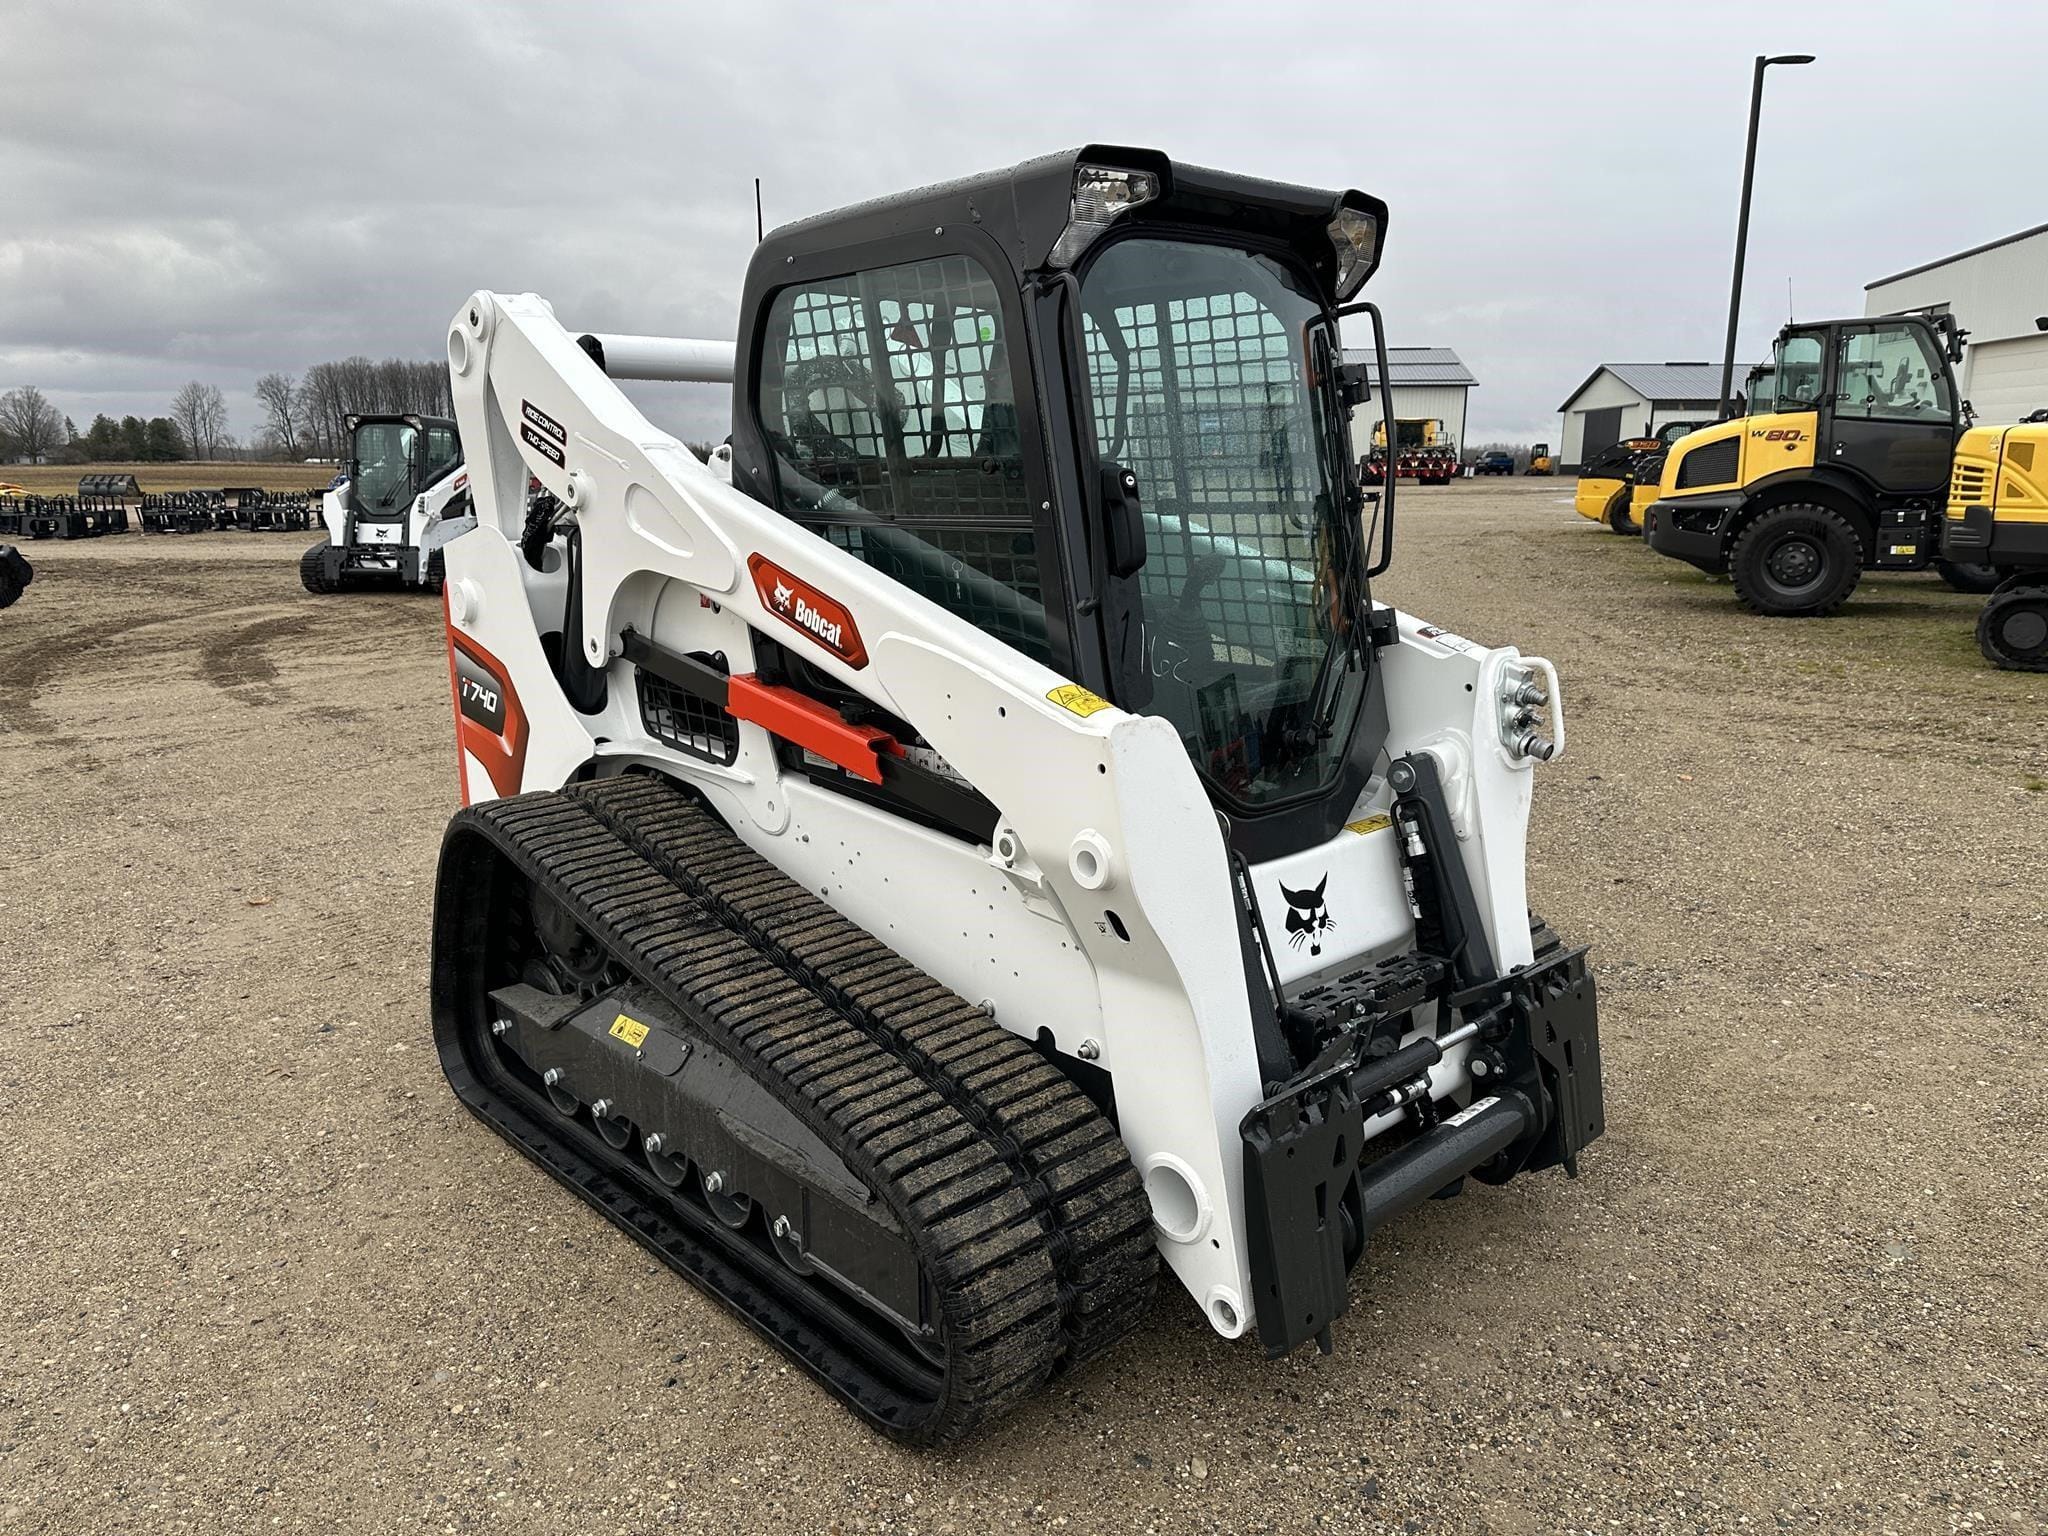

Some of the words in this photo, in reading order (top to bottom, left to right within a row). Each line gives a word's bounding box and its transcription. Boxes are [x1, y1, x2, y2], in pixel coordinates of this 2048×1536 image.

[525, 406, 539, 422] RIDE
[538, 416, 564, 440] CONTROL
[527, 431, 560, 460] TWO-SPEED
[794, 597, 843, 648] Bobcat
[462, 676, 498, 713] T740
